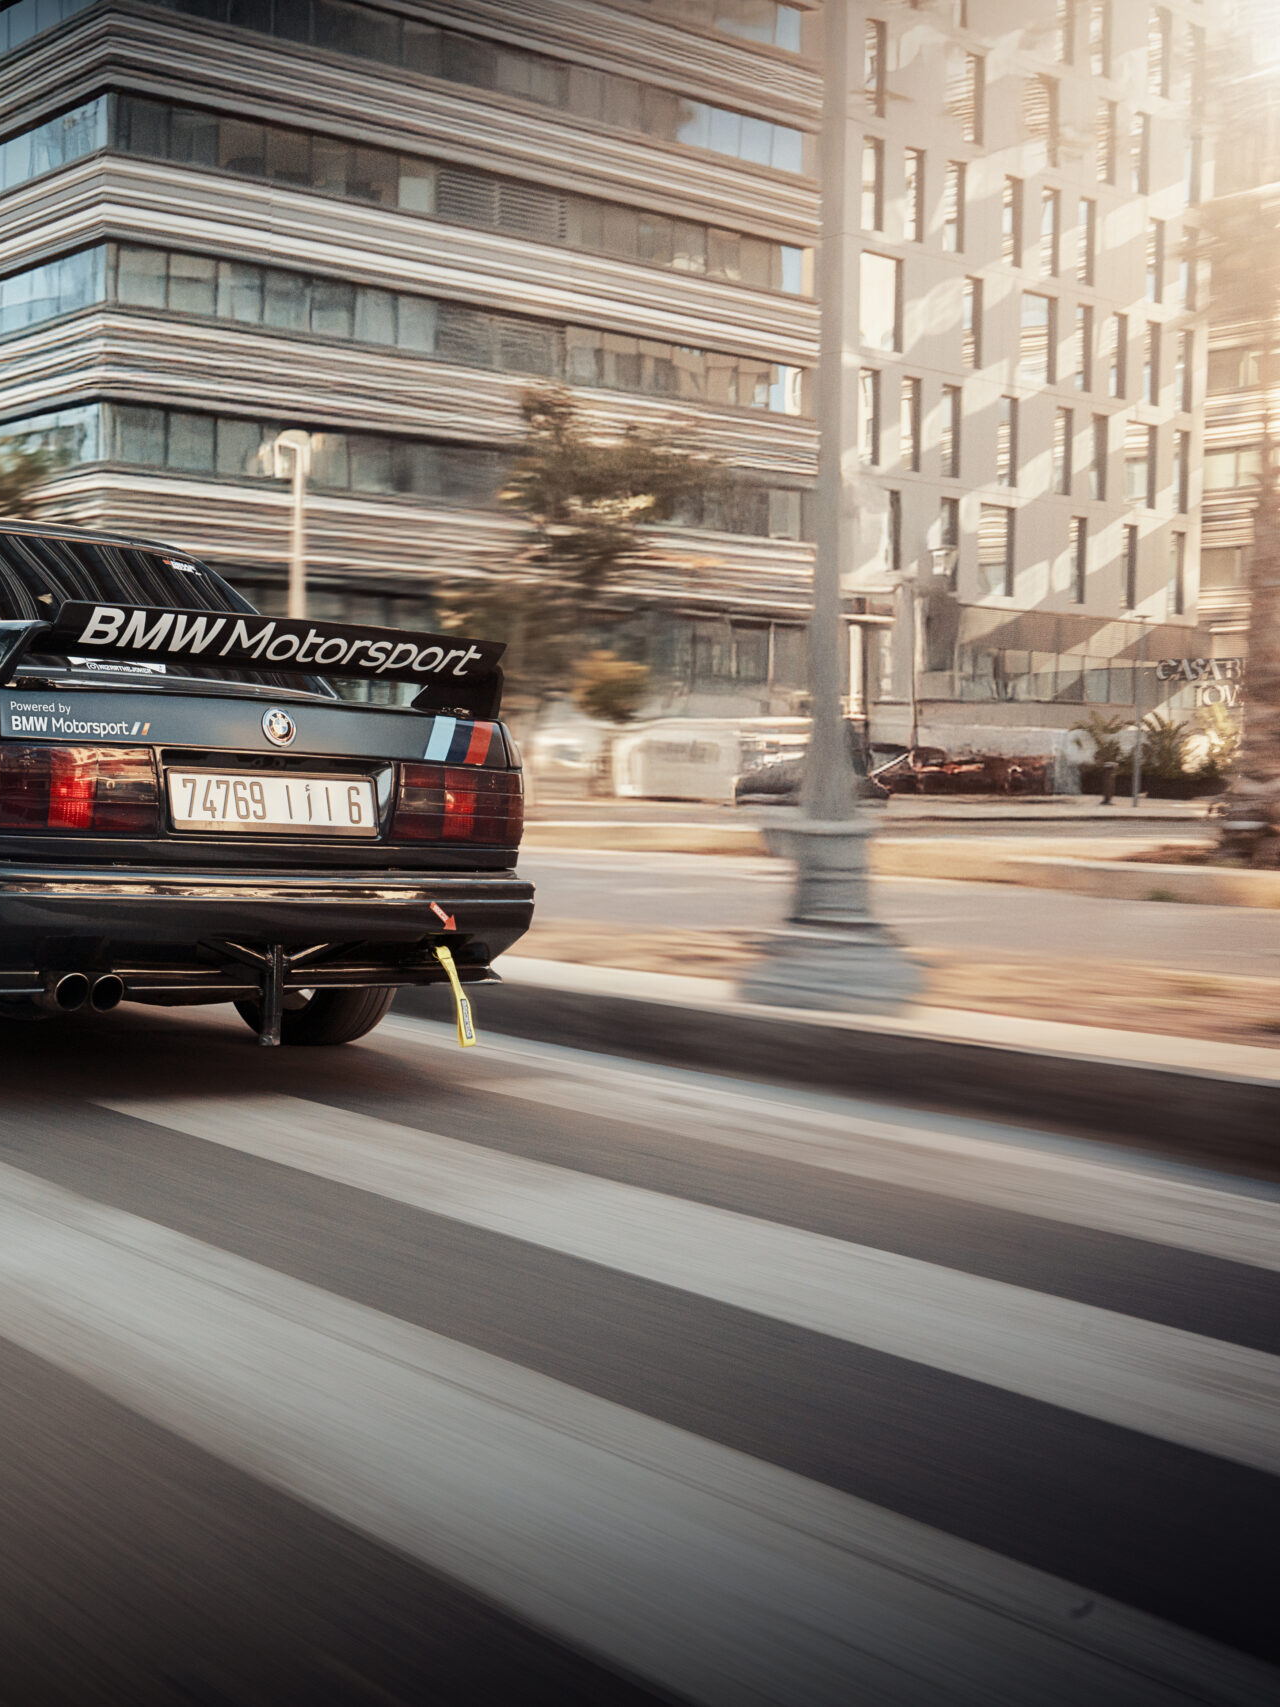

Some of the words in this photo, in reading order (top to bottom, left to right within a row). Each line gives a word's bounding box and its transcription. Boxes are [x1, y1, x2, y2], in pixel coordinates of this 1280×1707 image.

[77, 606, 227, 655] BMW
[220, 619, 483, 676] Motorsport
[9, 701, 56, 713] Powered
[58, 703, 72, 715] by
[11, 715, 49, 732] BMW
[51, 717, 130, 738] Motorsport
[182, 778, 267, 820] 74769
[347, 785, 362, 824] 6
